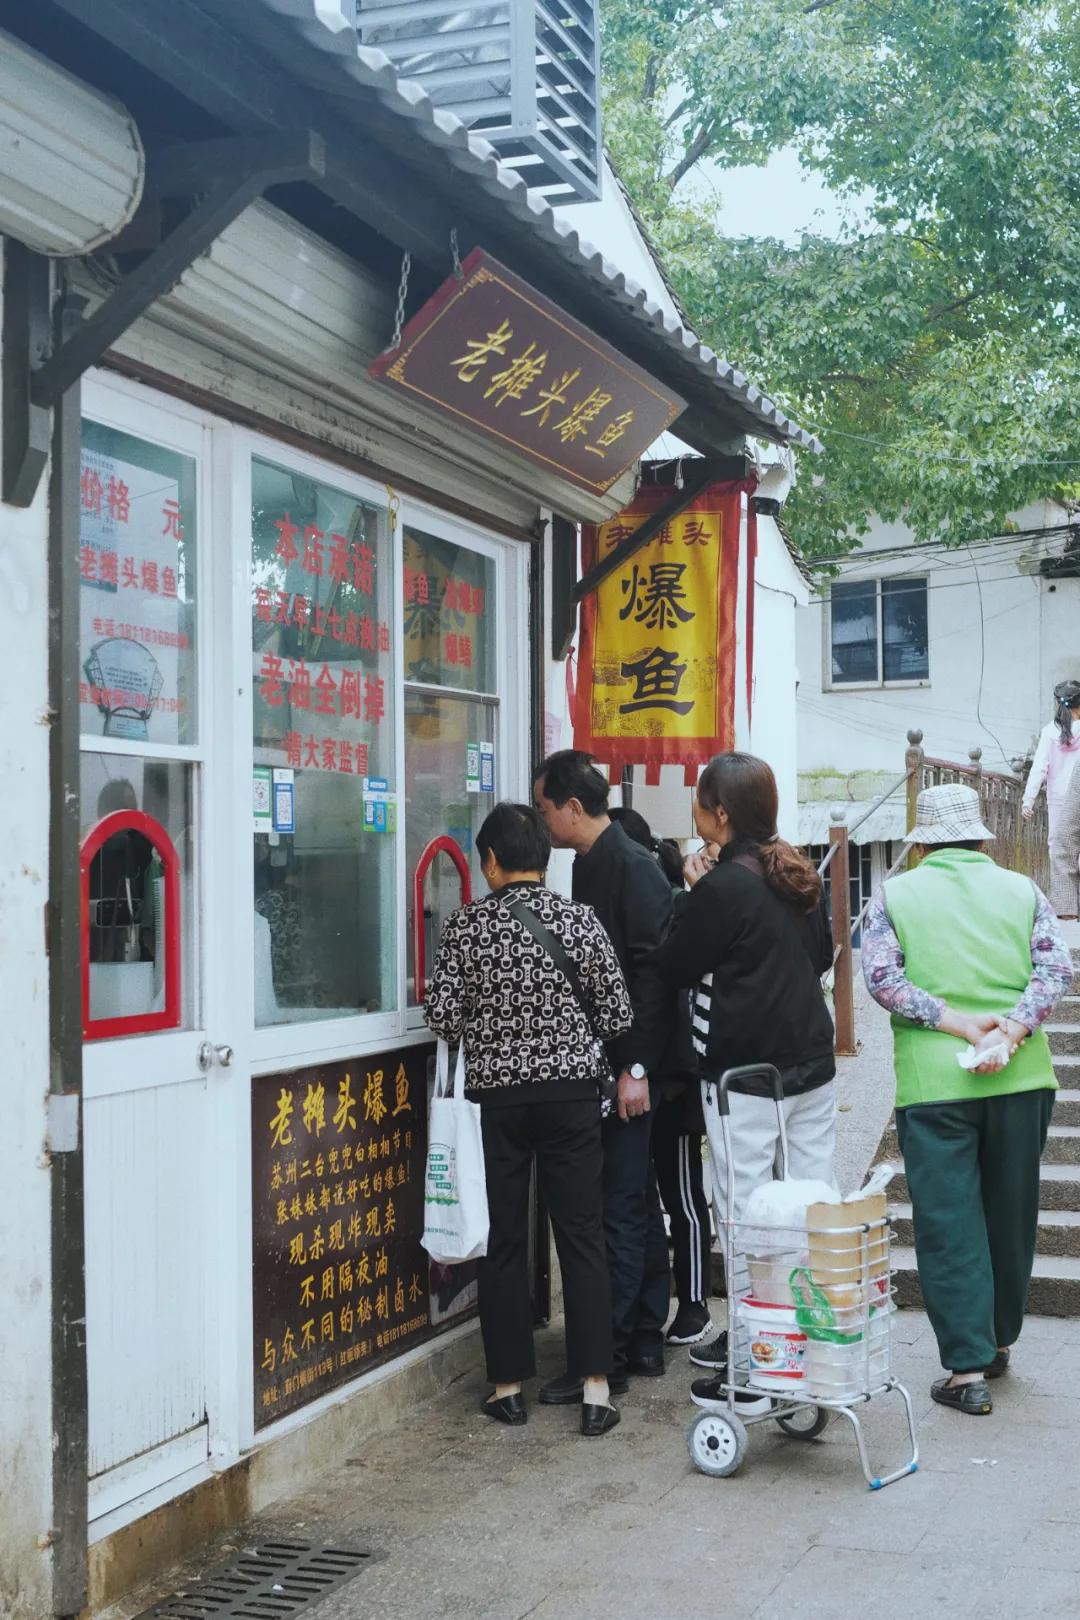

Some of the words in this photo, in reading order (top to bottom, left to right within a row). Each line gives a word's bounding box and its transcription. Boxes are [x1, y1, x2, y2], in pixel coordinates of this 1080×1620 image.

[80, 466, 130, 523] 价格
[161, 498, 184, 541] 元
[272, 512, 374, 598] 本店承诺
[619, 561, 696, 716] 爆鱼
[260, 651, 385, 726] 老油全倒掉
[285, 730, 368, 777] 请大家监督
[289, 1197, 396, 1265] 现杀现炸现卖
[299, 1247, 388, 1308] 不用隔夜油
[261, 1272, 424, 1373] 与众不同的秘制卤水
